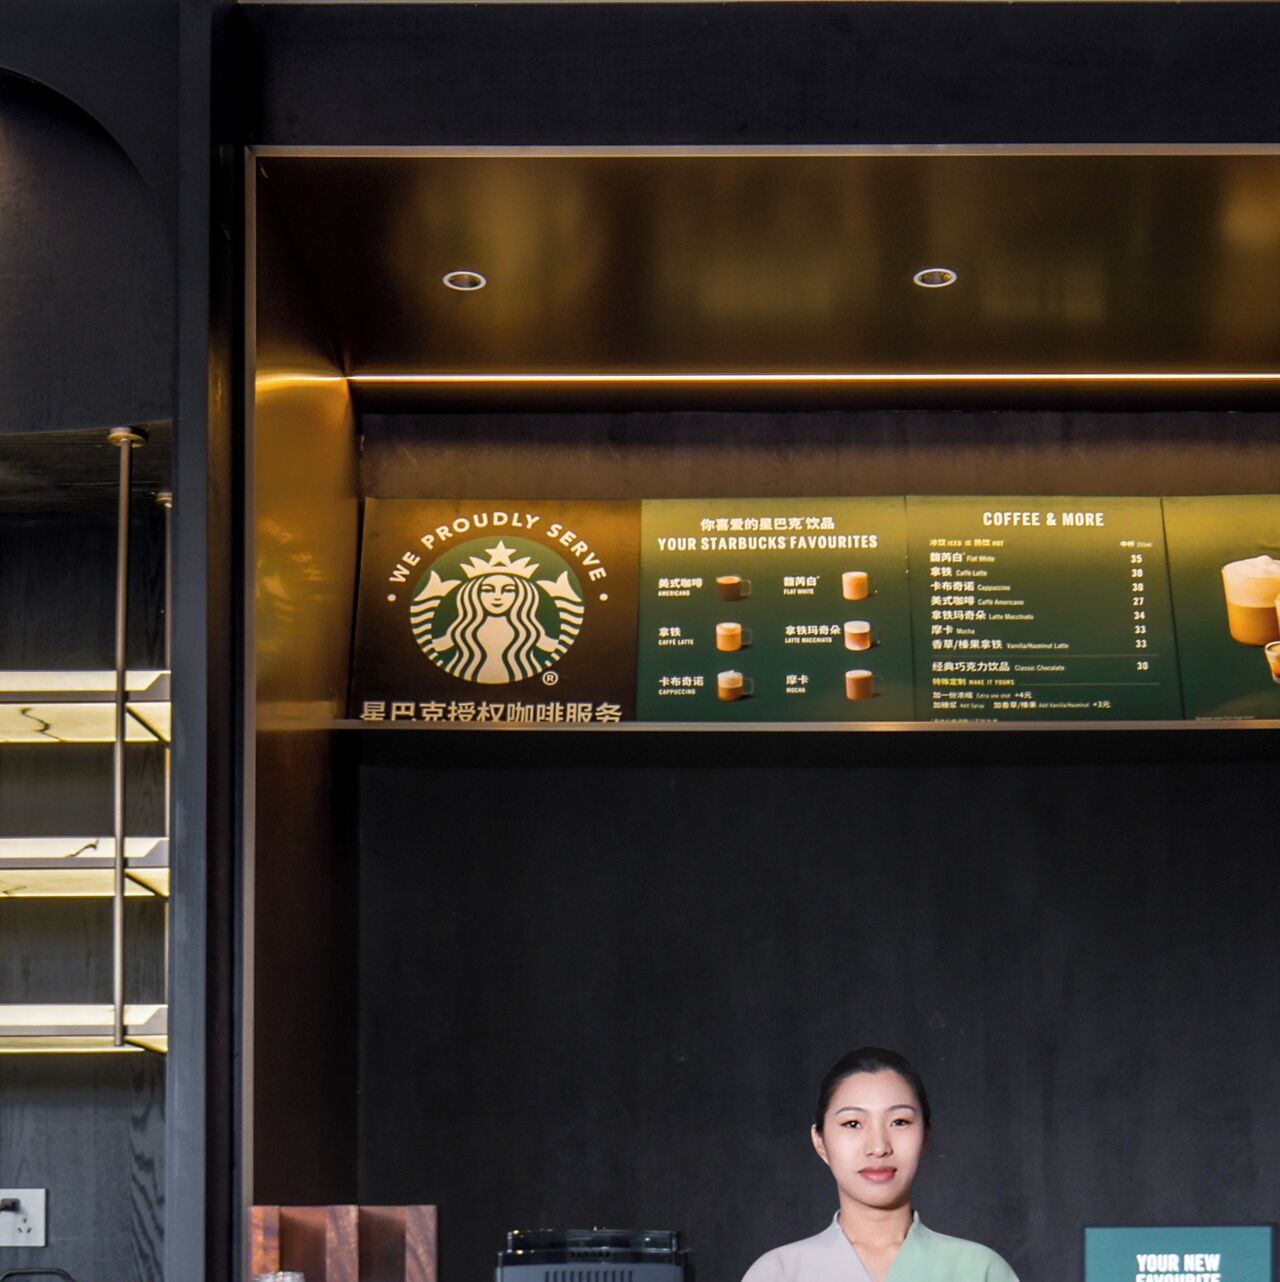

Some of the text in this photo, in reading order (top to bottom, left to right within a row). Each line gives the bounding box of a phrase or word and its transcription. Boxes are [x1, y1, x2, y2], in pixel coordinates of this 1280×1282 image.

[983, 512, 1104, 527] COFFEE & MORE
[389, 511, 607, 583] WE PROUDLY SERVE
[658, 535, 878, 551] YOUR STARBUCKS FAVOURITES
[1130, 554, 1143, 564] 35
[930, 581, 975, 591] 卡布奇诺
[784, 588, 796, 596] FLAT
[1133, 597, 1145, 606] 27
[931, 610, 986, 620] 拿铁玛奇朵
[1133, 611, 1146, 620] 34
[658, 627, 681, 637] 拿铁
[785, 625, 841, 636] 拿铁玛奇朵
[931, 625, 953, 635] 摩卡
[1134, 625, 1147, 634] 33
[1135, 639, 1148, 649] 33
[932, 661, 1010, 672] 经典巧克力饮品
[658, 676, 704, 687] 卡布奇诺
[786, 674, 809, 686] 摩卡
[360, 701, 622, 722] 星巴克授权咖啡服务
[1136, 1253, 1221, 1272] YOUR NEW
